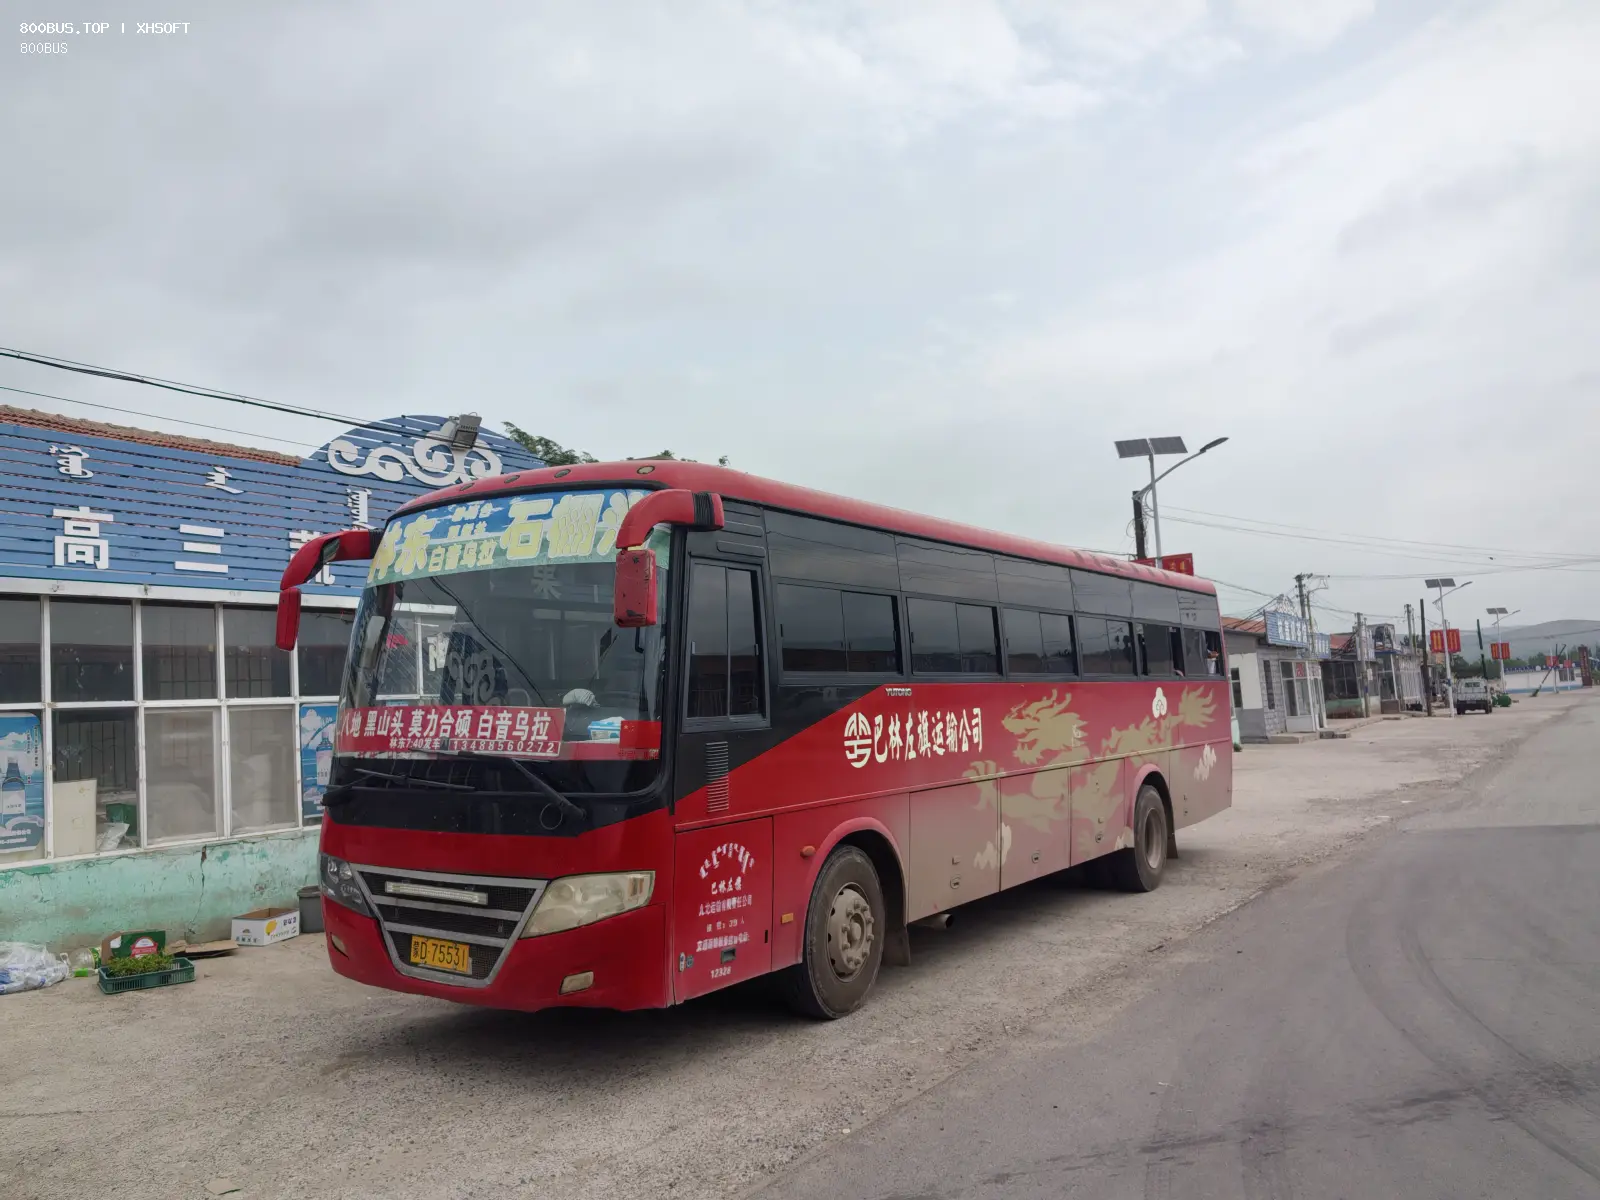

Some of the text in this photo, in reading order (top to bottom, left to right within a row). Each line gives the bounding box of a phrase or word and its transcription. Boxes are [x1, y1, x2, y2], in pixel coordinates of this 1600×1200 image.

[885, 687, 912, 697] YUTONG
[363, 710, 404, 737] 黑山头
[408, 708, 472, 739] 莫力合硕
[476, 710, 552, 742] 白音乌拉
[874, 707, 983, 764] 巴林左旗运输公司
[389, 737, 441, 750] 林东7:40发车
[453, 739, 555, 753] 13488560272
